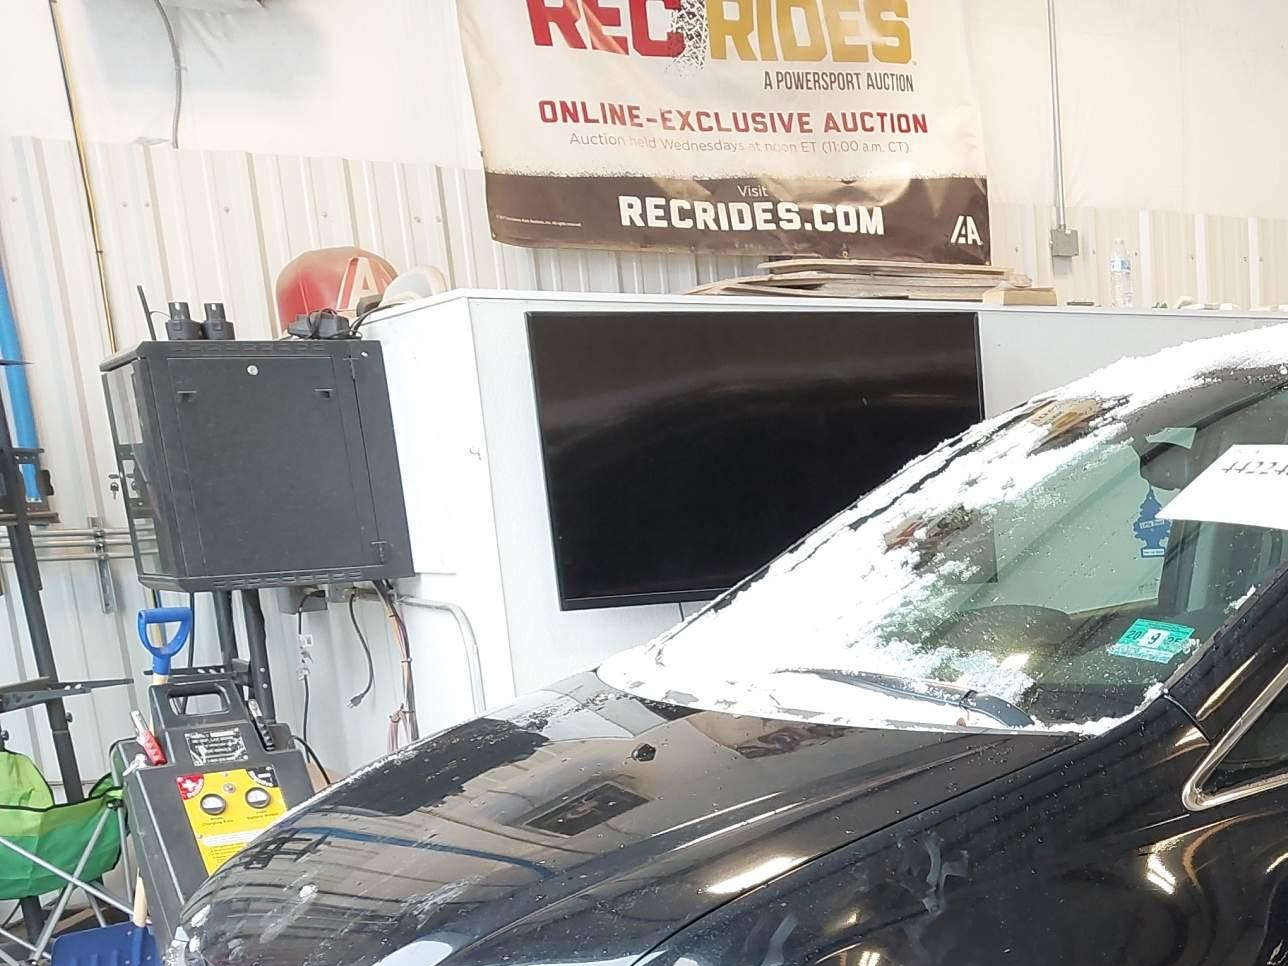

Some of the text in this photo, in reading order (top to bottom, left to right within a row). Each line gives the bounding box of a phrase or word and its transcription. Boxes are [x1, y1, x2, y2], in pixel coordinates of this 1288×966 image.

[706, 0, 913, 65] RIDES
[763, 71, 915, 93] A POWERSPORT AUCTION
[538, 100, 929, 134] ONLINE-EXCLUSIVE AUCTION
[569, 132, 626, 146] Auction
[629, 135, 657, 149] held
[659, 137, 745, 153] Wednesdays
[800, 141, 817, 153] ET
[822, 139, 859, 154] (11:00
[737, 184, 769, 198] Visit
[618, 196, 885, 236] RECRIDES.COM
[1125, 630, 1143, 640] 20
[1147, 632, 1162, 645] 9
